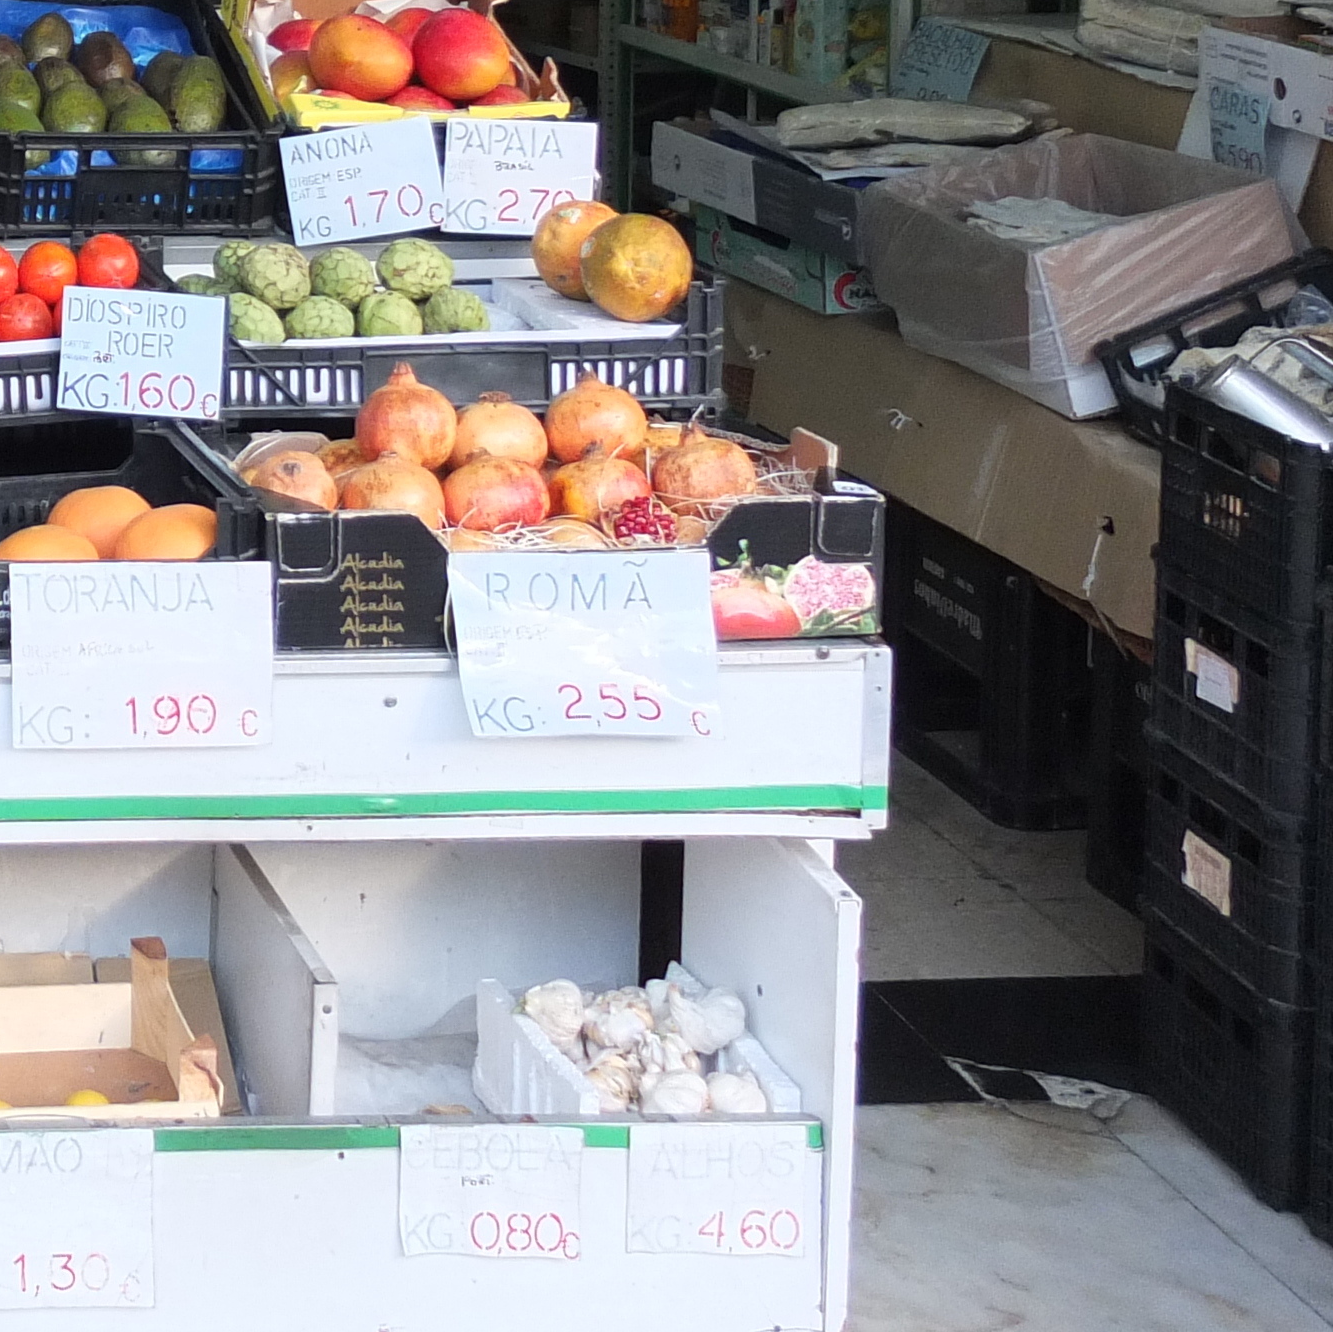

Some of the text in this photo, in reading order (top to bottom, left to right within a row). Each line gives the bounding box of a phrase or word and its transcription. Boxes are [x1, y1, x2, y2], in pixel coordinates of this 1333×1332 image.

[290, 131, 373, 166] ANONA
[448, 121, 563, 159] PAPAIA
[344, 183, 423, 228] 1,70
[68, 295, 186, 329] DIOSPIRO
[108, 330, 173, 358] ROER
[61, 371, 217, 418] KG: 1,60 €
[14, 573, 213, 613] TORANJA
[486, 558, 651, 611] ROMÃ
[19, 704, 89, 745] KG:
[125, 694, 217, 739] 1,90
[473, 697, 546, 733] KG:
[558, 683, 662, 727] 2,55
[405, 1132, 573, 1171] CEBOLA
[648, 1140, 796, 1180] ALHOS
[469, 1211, 563, 1258] 0,80
[698, 1209, 801, 1253] 4,60
[13, 1253, 110, 1297] 1,30
